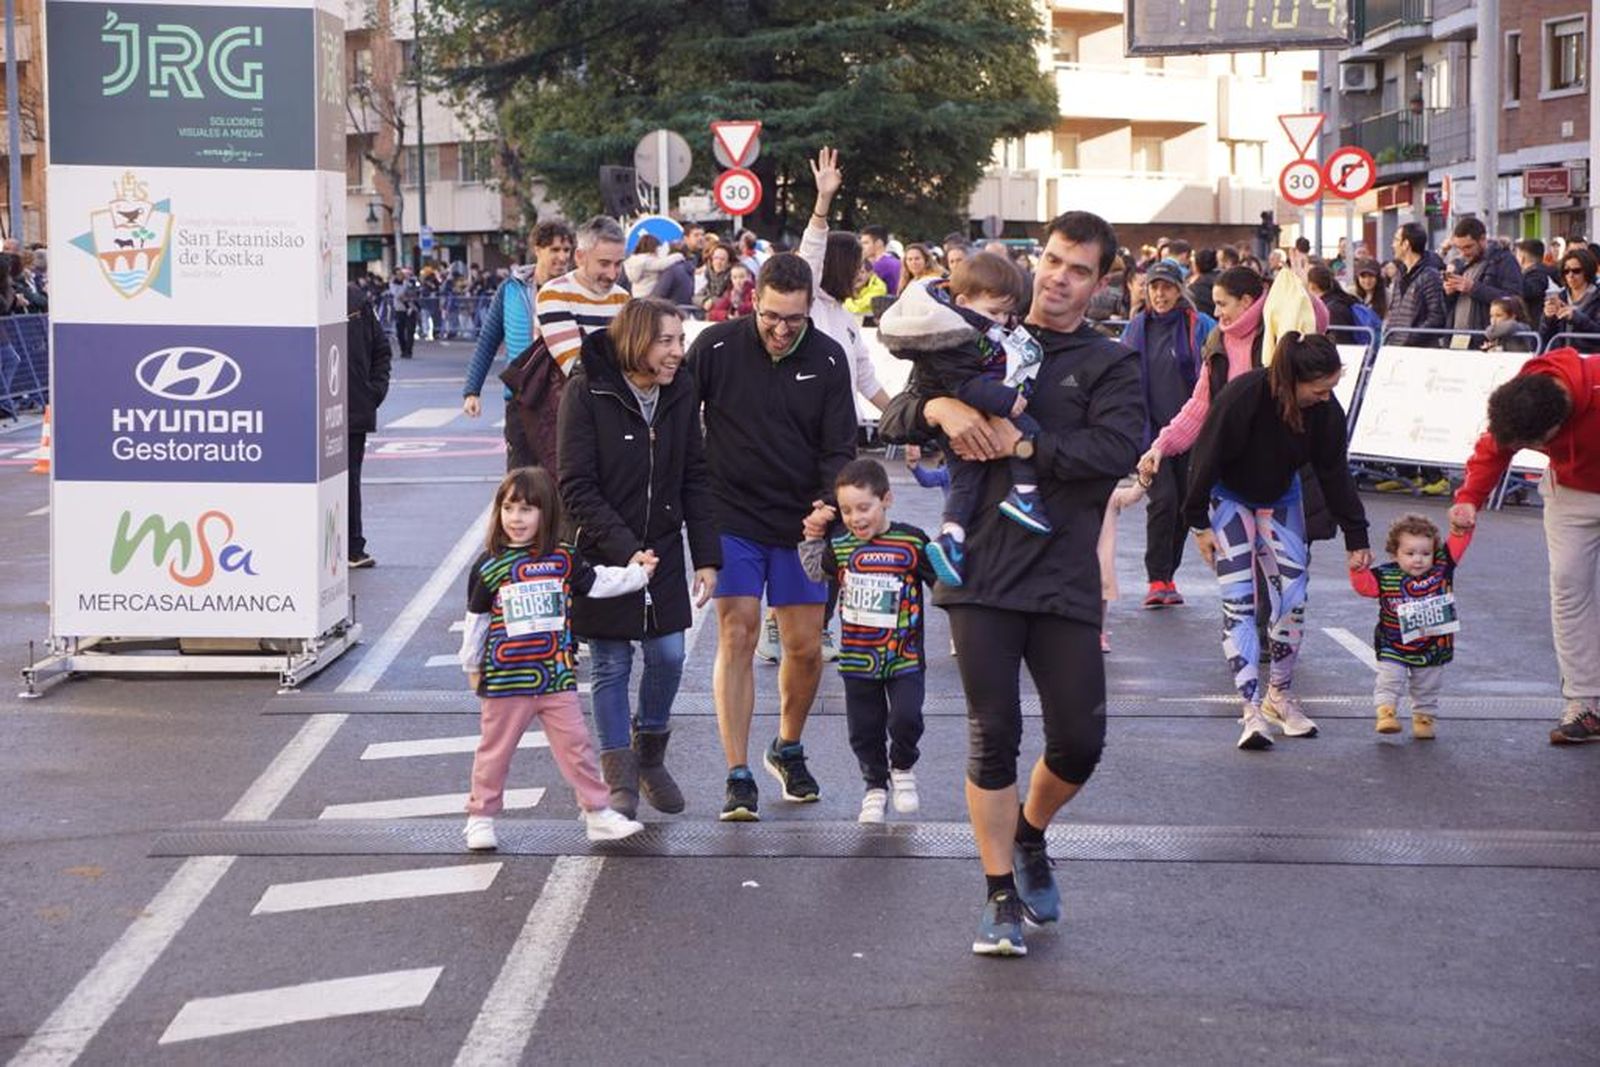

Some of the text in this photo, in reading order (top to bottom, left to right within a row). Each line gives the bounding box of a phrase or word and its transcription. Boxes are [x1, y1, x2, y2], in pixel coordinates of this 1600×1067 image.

[102, 21, 263, 100] JRG
[209, 116, 264, 127] SOLUCIONES
[178, 127, 264, 138] VISUALES A MEDIDA
[1289, 174, 1315, 190] 30
[725, 185, 750, 201] 30
[178, 229, 305, 248] San Estanislao
[178, 247, 264, 267] de Kostka
[112, 408, 264, 434] HYUNDAI
[111, 436, 263, 463] Gestorauto
[78, 593, 297, 613] MERCASALAMANCA
[510, 593, 554, 619] 6083
[1406, 607, 1445, 630] 5986
